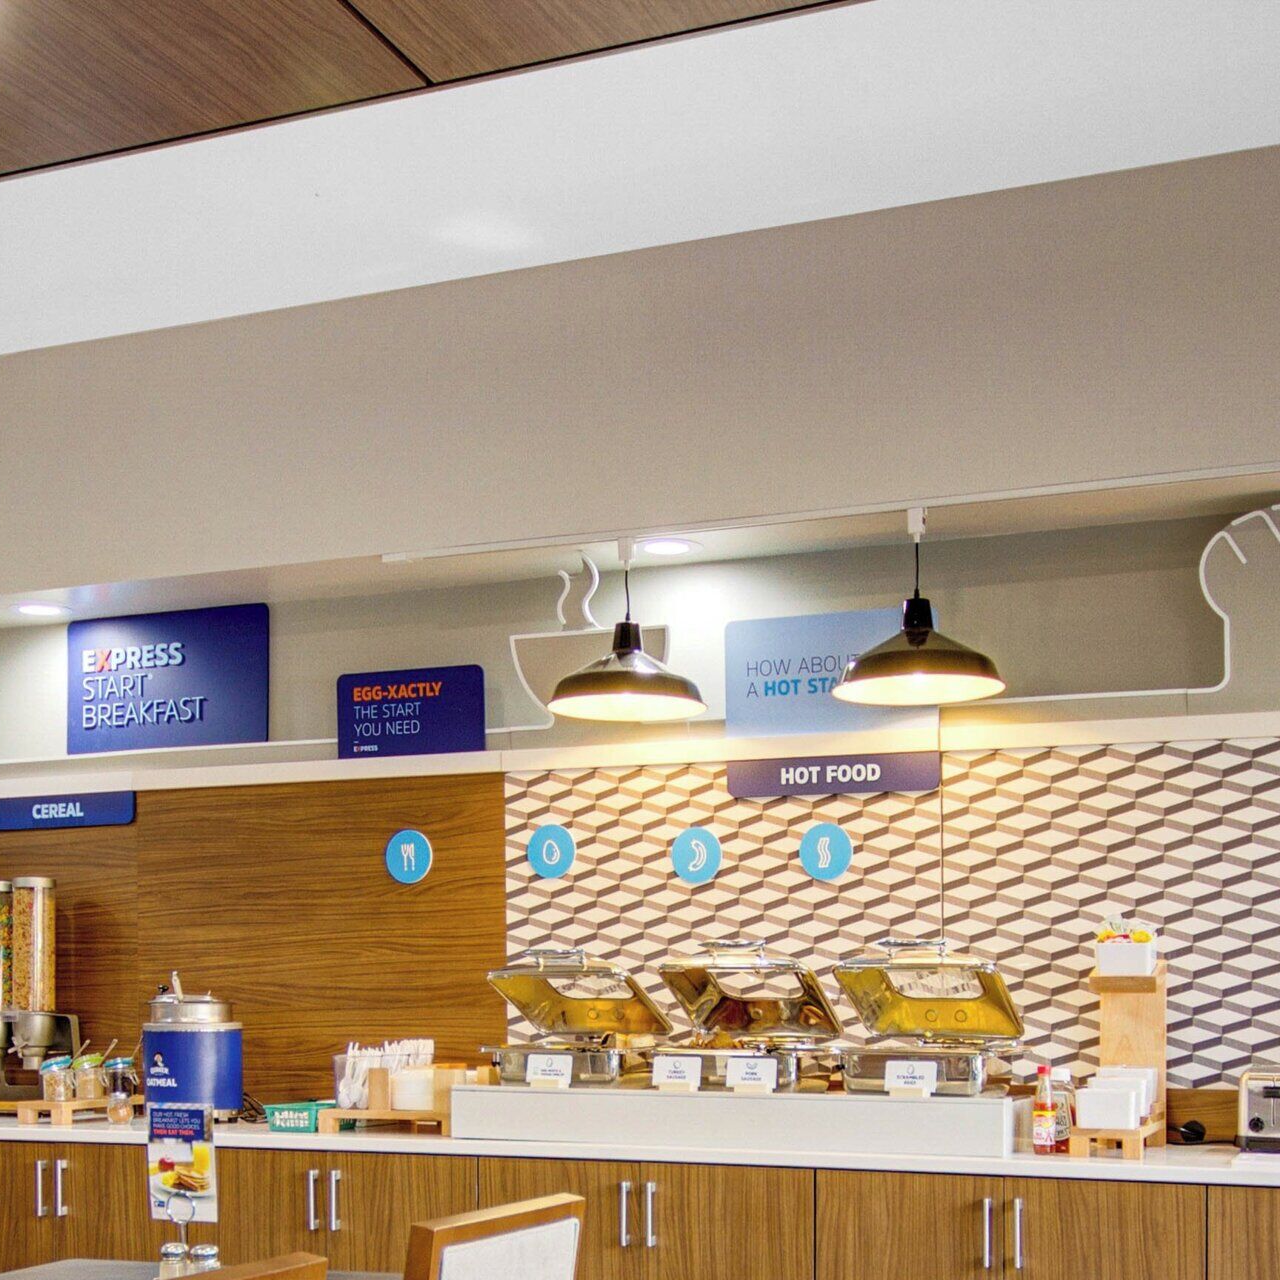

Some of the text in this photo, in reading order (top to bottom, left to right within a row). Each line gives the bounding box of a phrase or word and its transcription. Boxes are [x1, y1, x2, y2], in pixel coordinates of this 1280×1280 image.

[82, 641, 184, 674] EXPRESS
[746, 659, 791, 677] HOW
[353, 681, 442, 702] EGG-XACTLY
[746, 682, 759, 697] A
[764, 680, 801, 697] HOT
[82, 696, 208, 729] BREAKFAST
[354, 702, 422, 720] THE START
[354, 720, 420, 737] YOU NEED
[780, 764, 881, 785] HOT FOOD
[32, 802, 84, 820] CEREAL
[146, 1078, 177, 1087] OATMEAL
